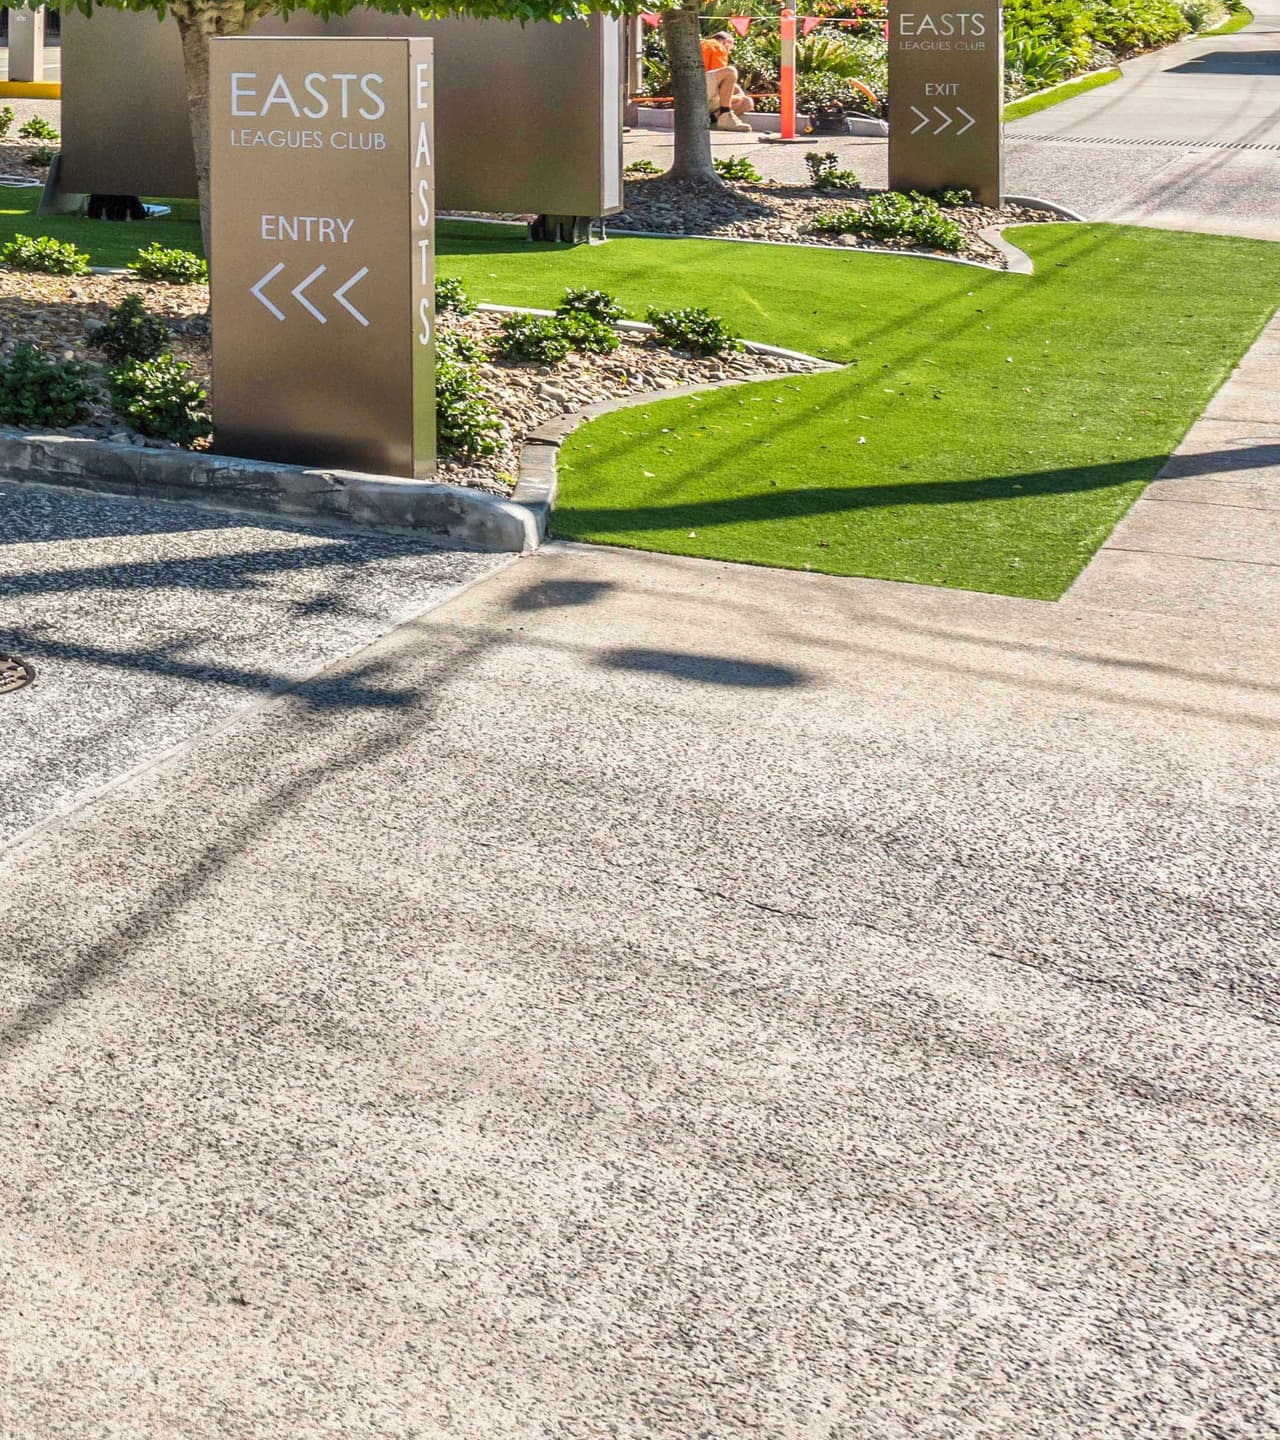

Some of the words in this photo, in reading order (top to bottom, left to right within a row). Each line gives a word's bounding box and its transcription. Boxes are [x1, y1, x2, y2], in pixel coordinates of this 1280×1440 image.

[899, 12, 986, 37] EASTS
[899, 40, 951, 51] LEAGUES
[953, 40, 986, 51] CLUB
[230, 71, 386, 120] EASTS
[924, 82, 961, 97] EXIT
[230, 128, 324, 150] LEAGUES
[330, 130, 387, 151] CLUB
[414, 62, 431, 346] EASTS
[260, 214, 356, 244] ENTRY
